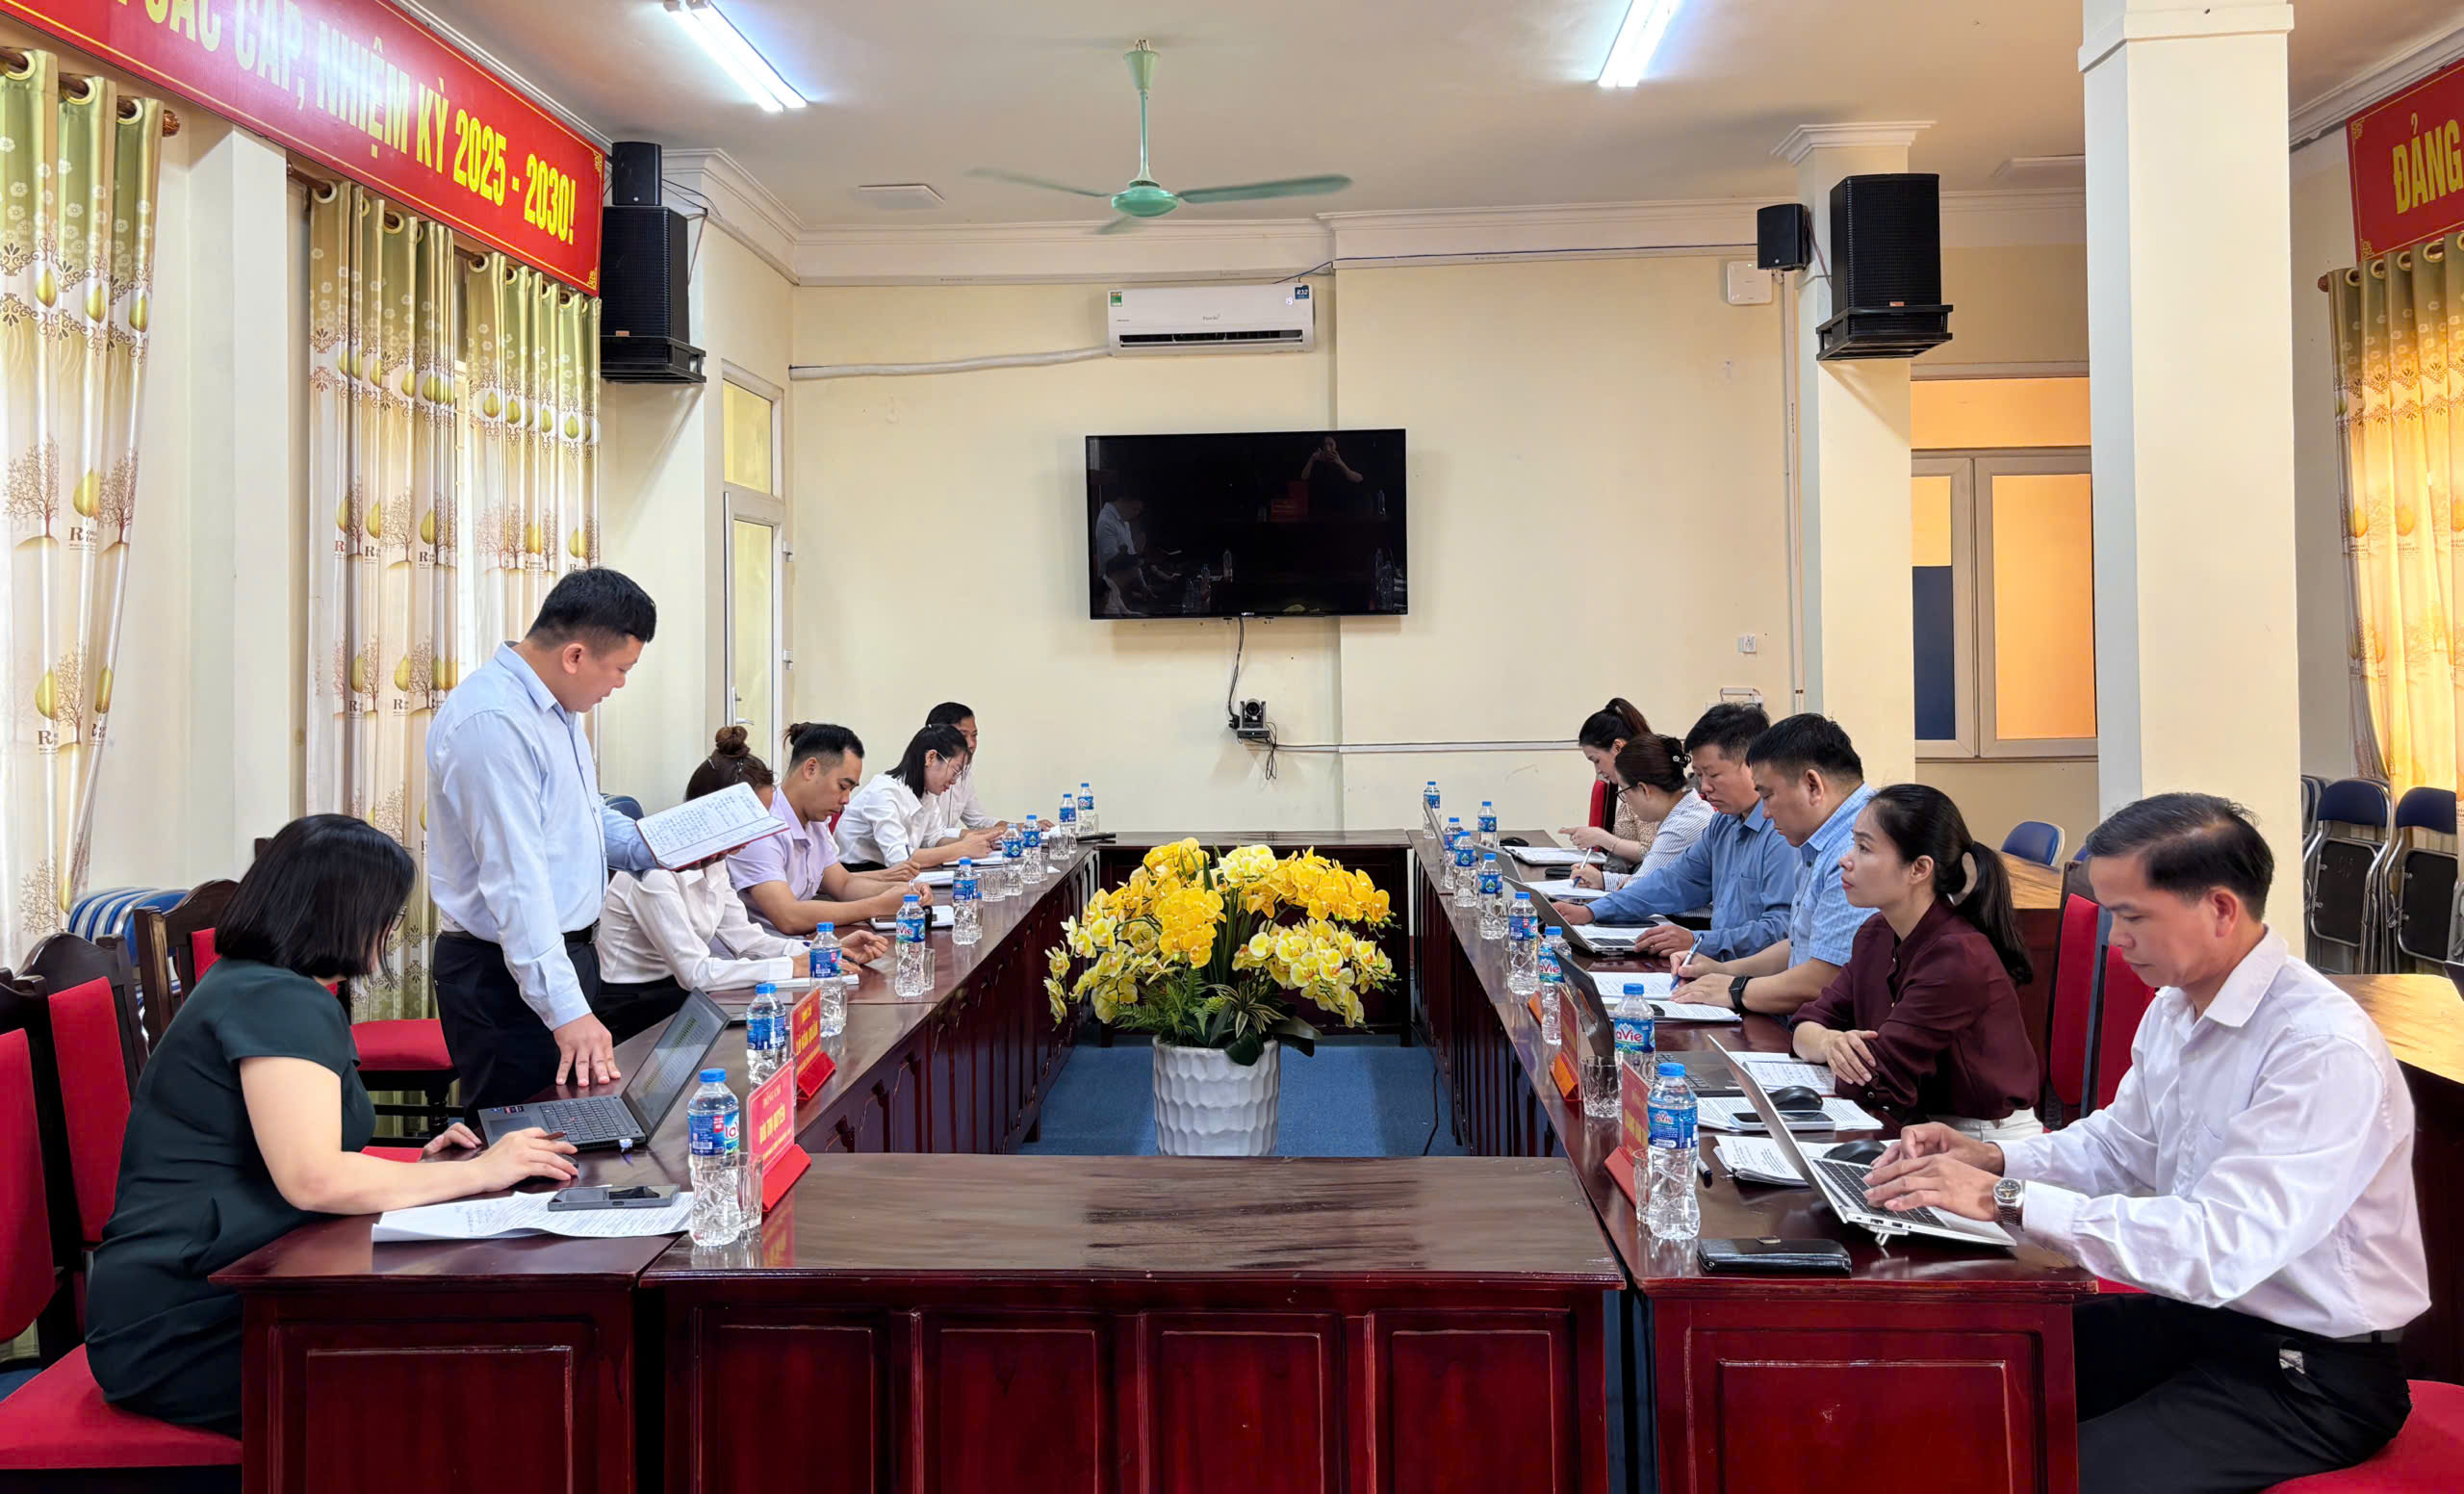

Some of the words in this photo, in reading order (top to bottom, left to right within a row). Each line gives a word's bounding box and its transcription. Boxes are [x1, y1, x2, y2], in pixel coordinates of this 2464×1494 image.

[317, 21, 410, 159] NHIỆM
[417, 76, 449, 174] KỲ
[453, 109, 507, 206] 2025
[511, 176, 520, 193] -
[524, 153, 577, 245] 2030!
[2392, 113, 2464, 214] ĐẢNG
